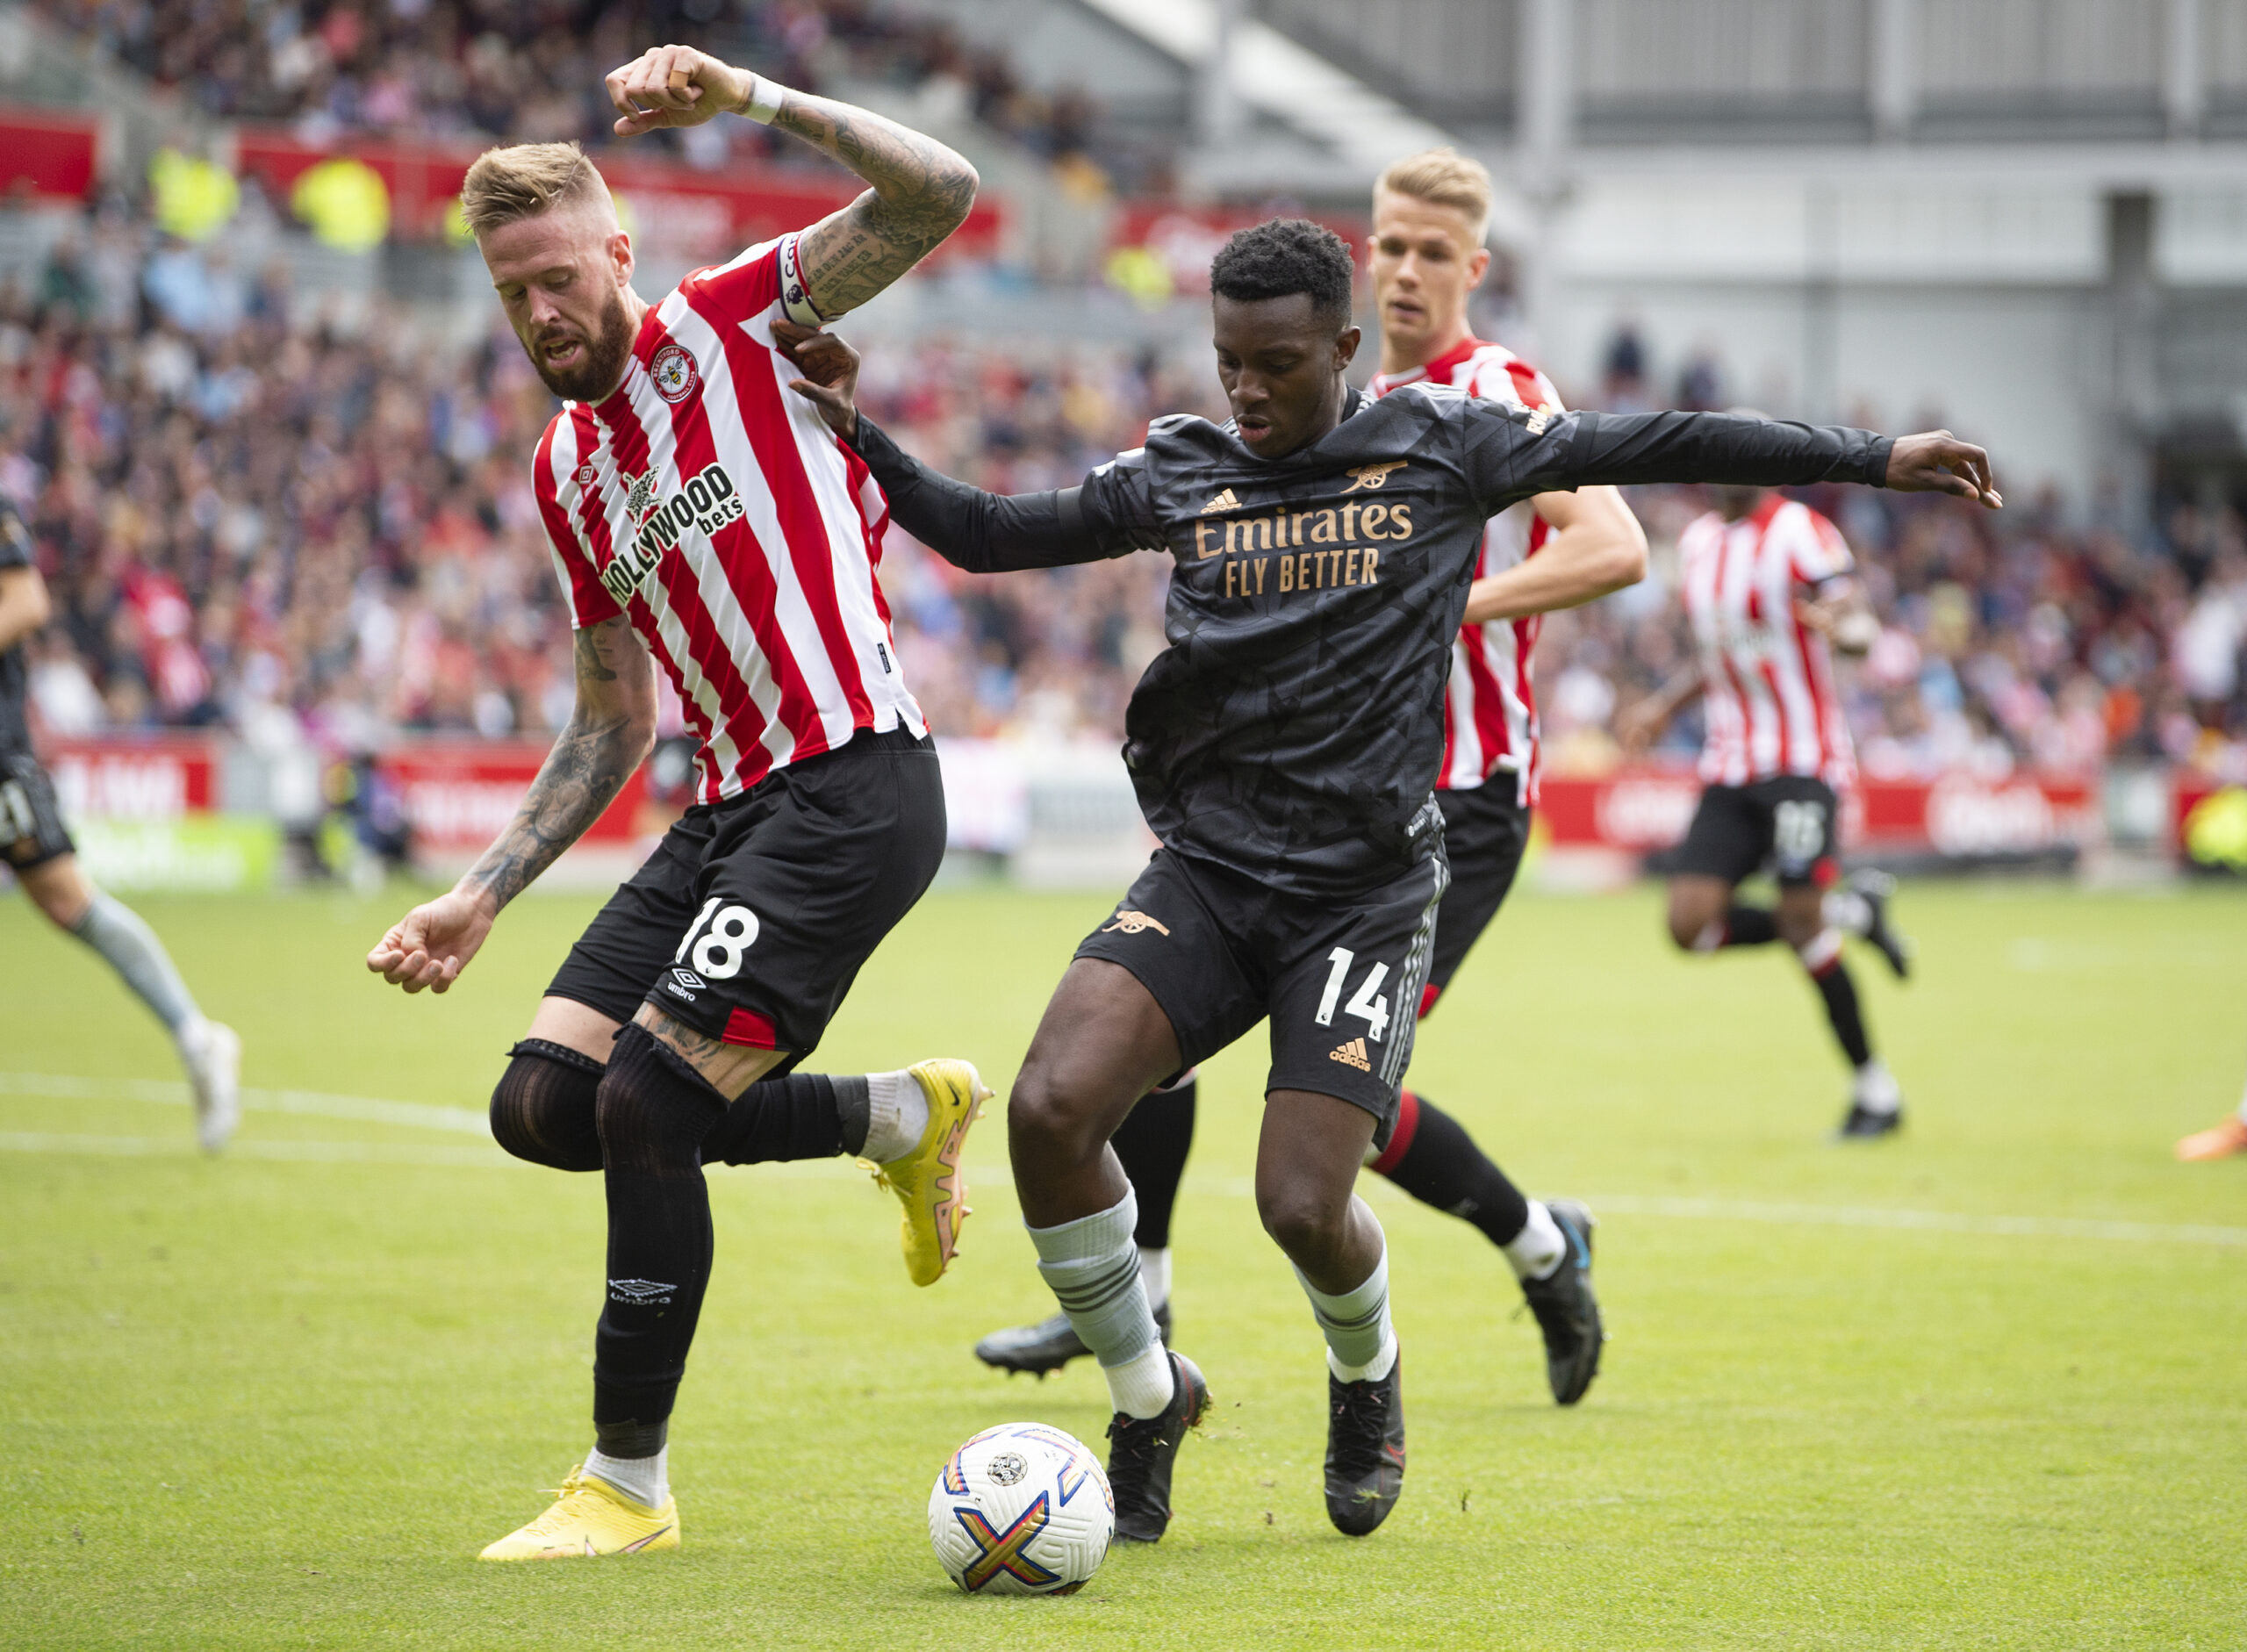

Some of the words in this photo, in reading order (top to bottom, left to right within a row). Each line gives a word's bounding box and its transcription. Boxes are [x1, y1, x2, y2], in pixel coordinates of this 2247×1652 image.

[696, 498, 743, 535] bets
[1195, 499, 1413, 560] Emirates
[1200, 502, 1242, 514] adidas
[602, 464, 734, 606] HOLLYWOOD
[1225, 557, 1268, 599] FLY
[1279, 548, 1380, 593] BETTER
[675, 897, 760, 980] 18
[667, 981, 696, 1002] umbro
[1315, 946, 1390, 1043] 14
[1329, 1050, 1372, 1073] adidas
[610, 1291, 671, 1305] umbro
